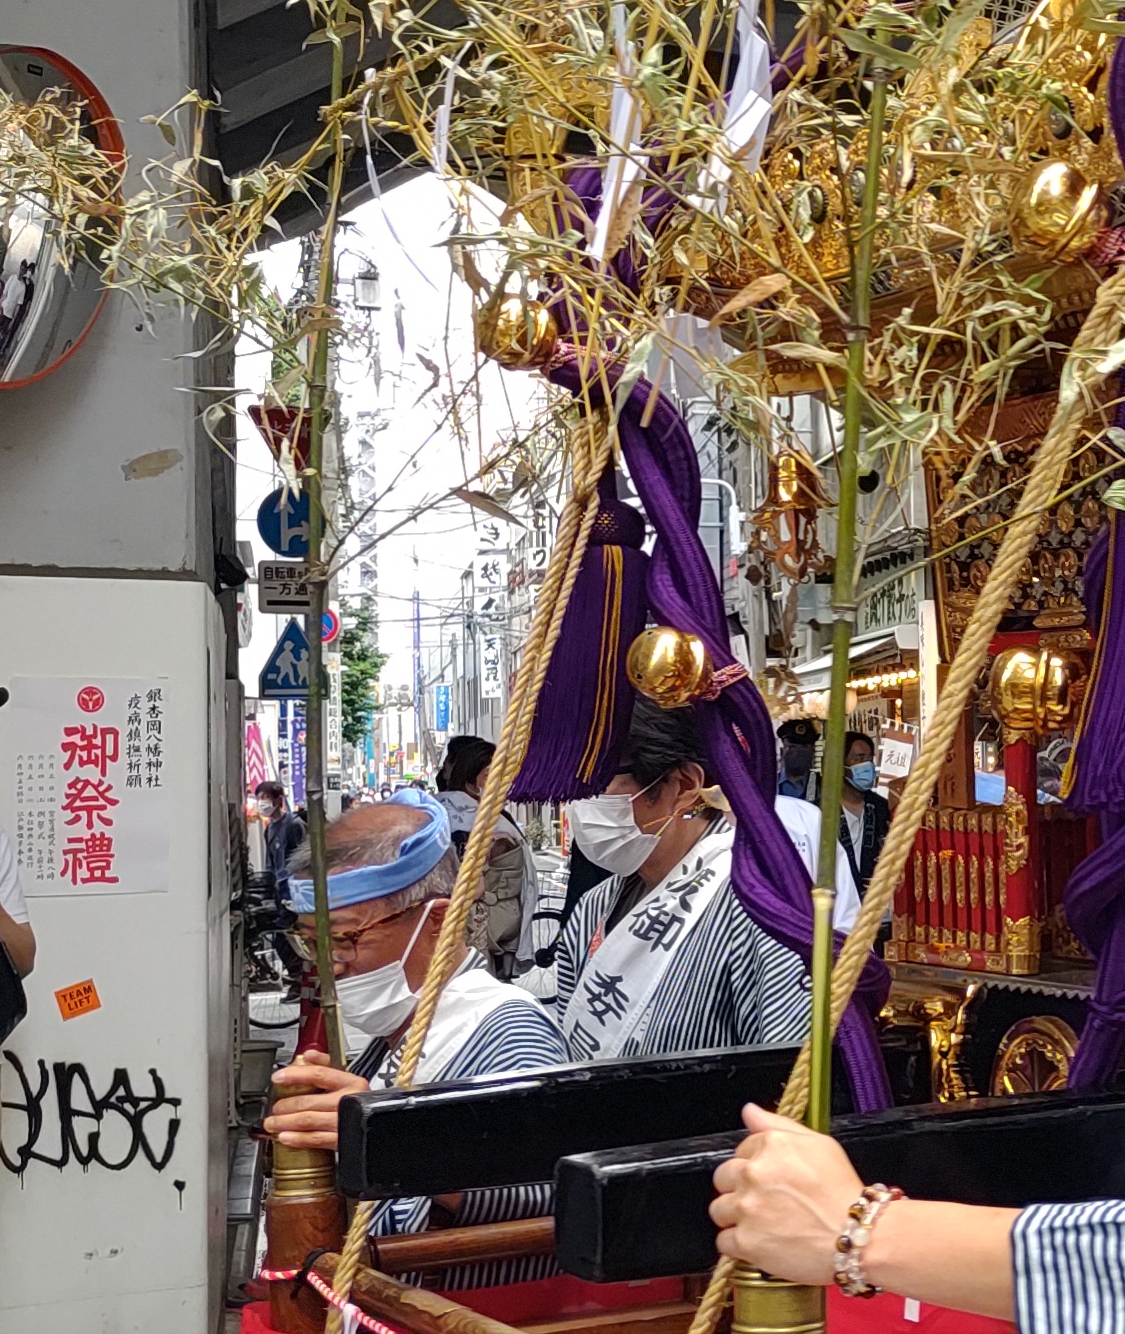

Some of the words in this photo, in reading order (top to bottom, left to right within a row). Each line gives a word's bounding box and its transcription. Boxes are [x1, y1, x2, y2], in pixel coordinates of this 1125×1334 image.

[264, 582, 315, 595] 一方通
[126, 693, 142, 788] 疫病鎮撫祈願
[145, 688, 164, 788] 銀杏岡八幡神社
[885, 750, 907, 767] 元祖
[60, 723, 120, 886] 御祭禮
[61, 984, 93, 1003] TEAM
[67, 995, 92, 1011] LIFT
